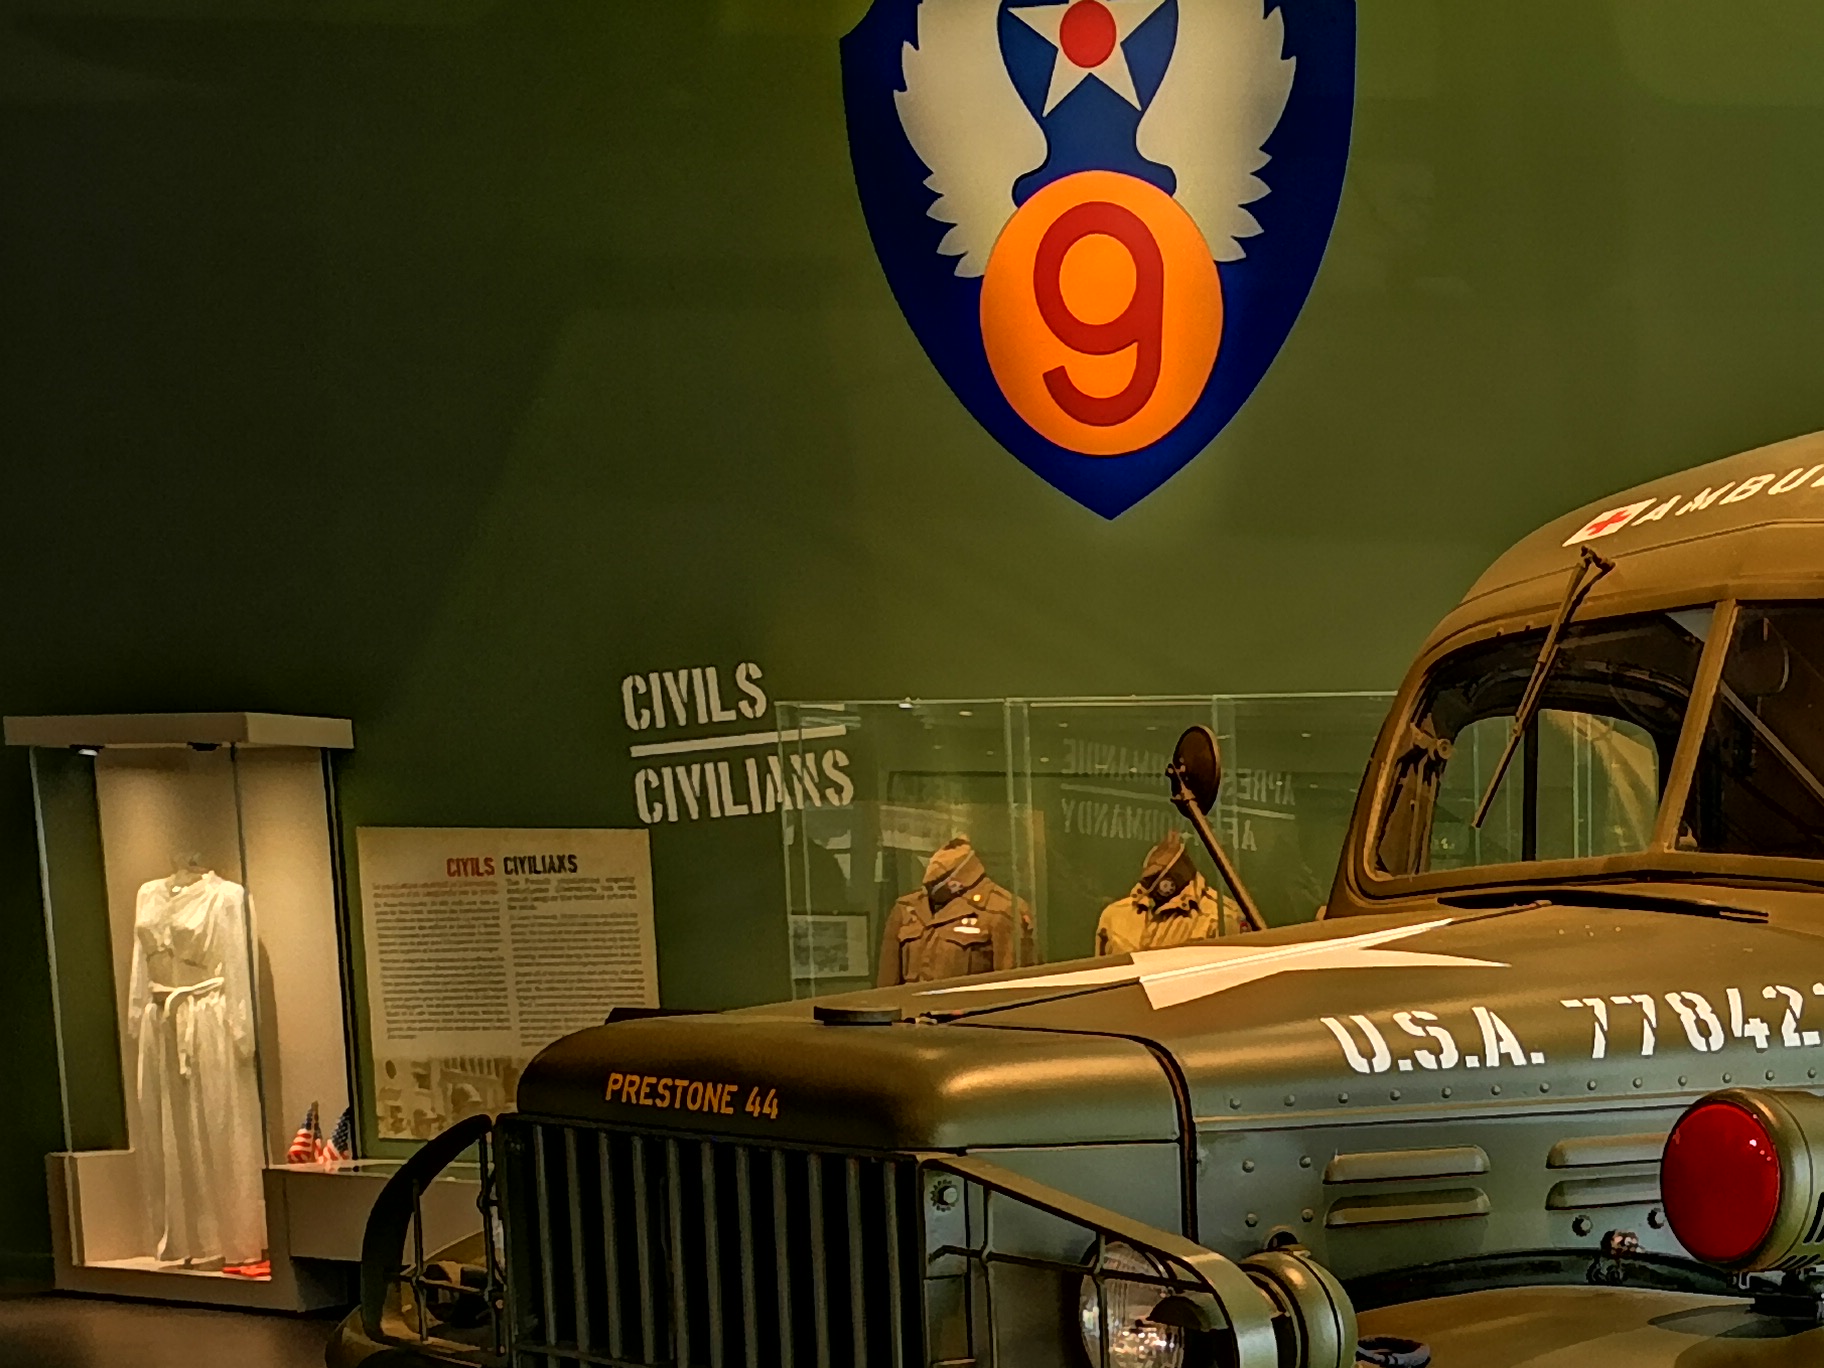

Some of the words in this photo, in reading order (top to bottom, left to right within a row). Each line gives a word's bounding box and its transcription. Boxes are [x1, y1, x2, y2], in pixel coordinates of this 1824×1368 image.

[1033, 200, 1164, 427] 9
[622, 662, 767, 730] CIVILS
[635, 750, 854, 823] CIVILIANS
[446, 857, 496, 878] CIVILS
[1320, 1006, 1544, 1075] U.S.A.
[605, 1072, 738, 1115] PRESTONE
[745, 1086, 778, 1119] 44
